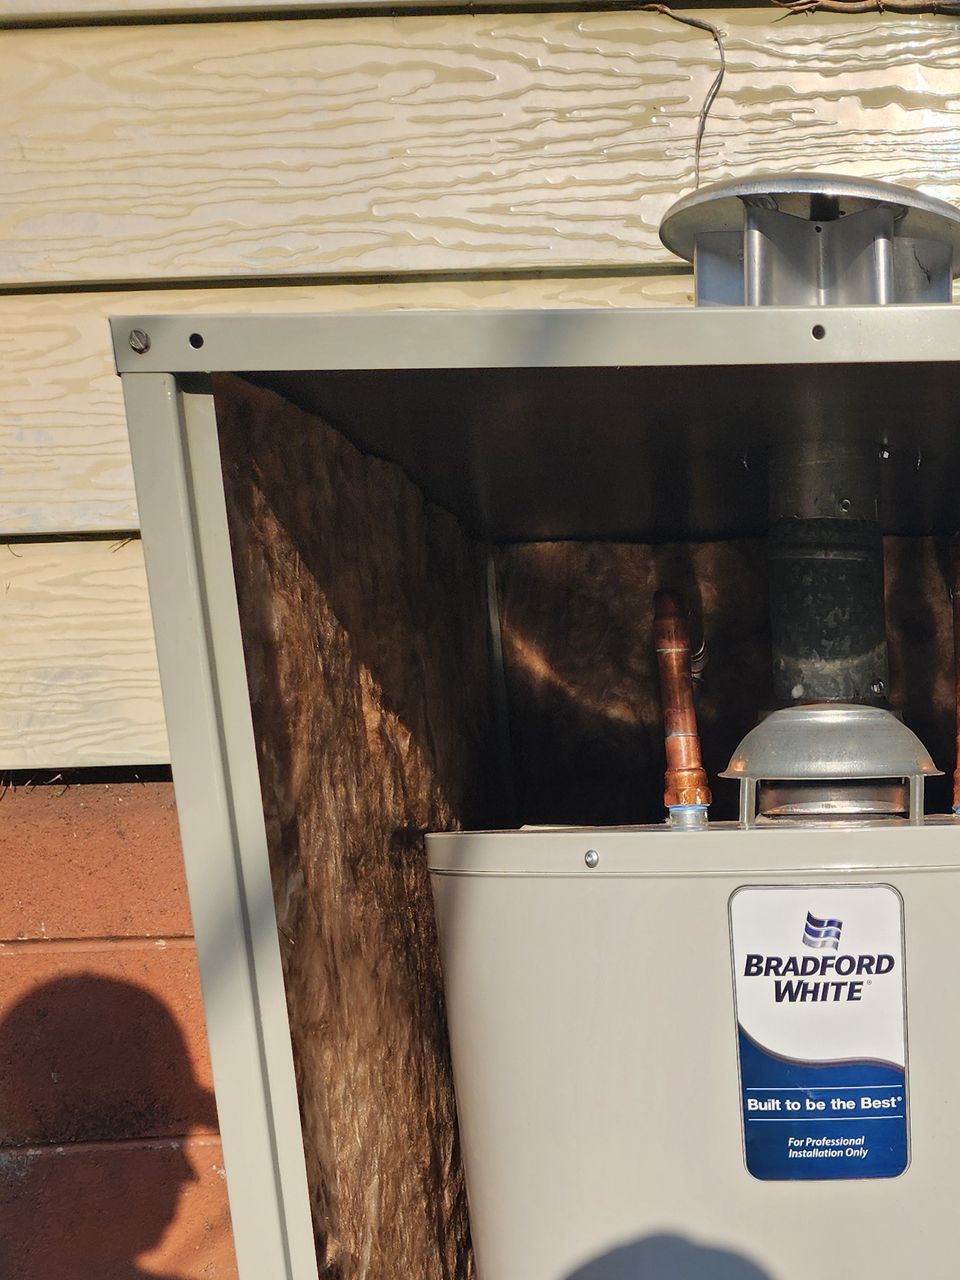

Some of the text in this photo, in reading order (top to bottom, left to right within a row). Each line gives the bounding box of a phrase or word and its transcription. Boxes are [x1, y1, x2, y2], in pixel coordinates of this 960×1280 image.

[744, 954, 895, 976] BRADFORD
[748, 1099, 781, 1111] Built
[785, 1099, 801, 1110] to
[805, 1099, 825, 1110] be
[831, 1098, 855, 1110] the
[788, 1136, 864, 1147] For Professional
[789, 1148, 868, 1159] Installation Only
